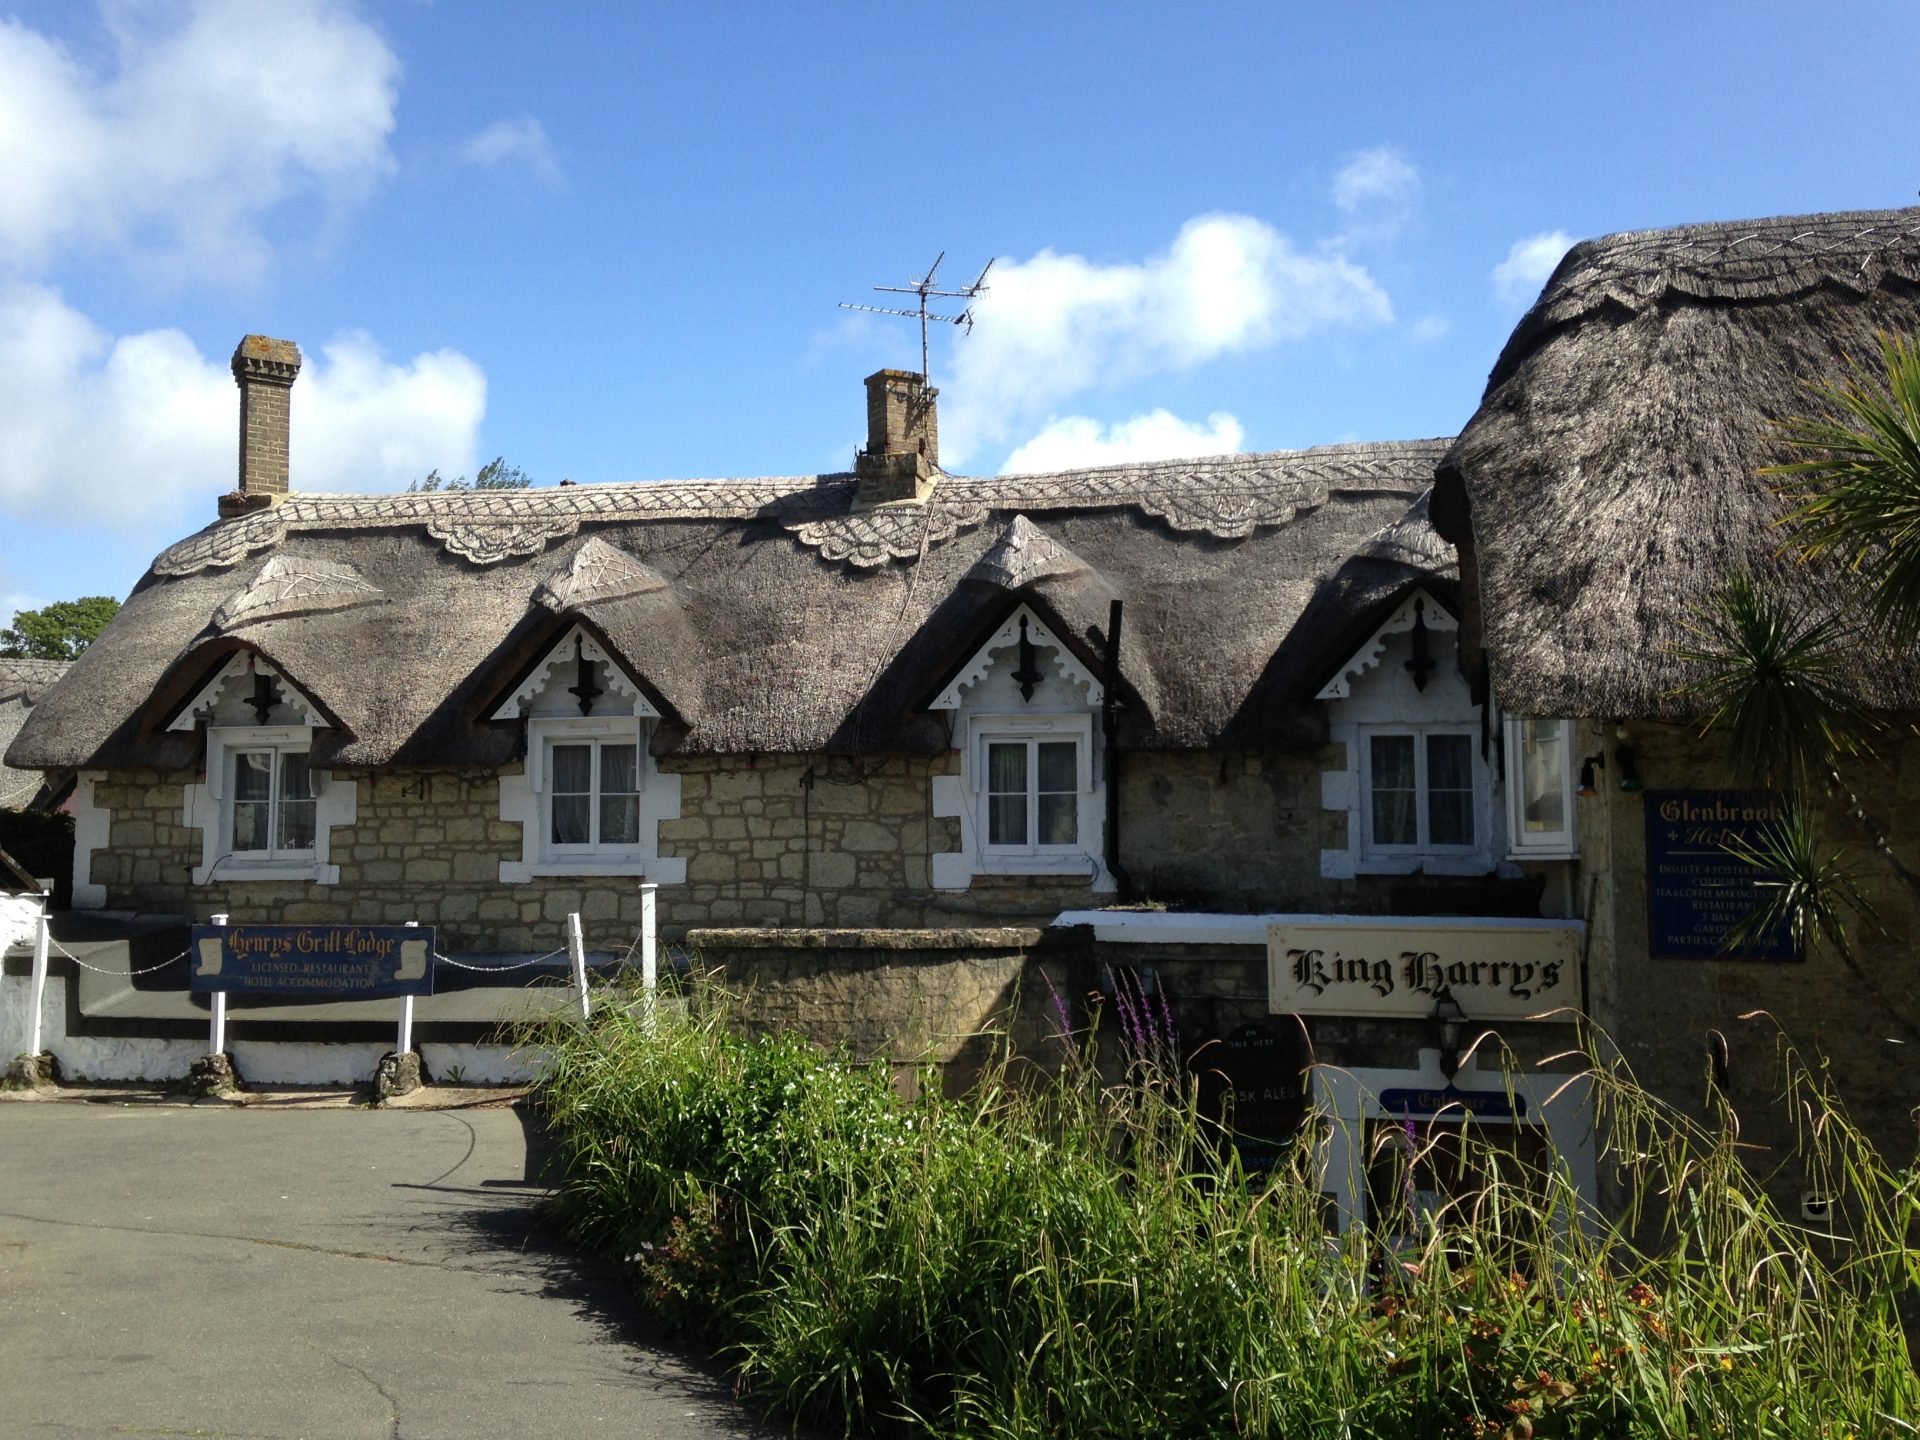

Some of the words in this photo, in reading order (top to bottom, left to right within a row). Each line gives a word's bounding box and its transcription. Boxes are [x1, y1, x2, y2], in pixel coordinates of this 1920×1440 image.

[1684, 826, 1746, 846] Hotel
[1659, 864, 1700, 875] ENSUITE
[1703, 865, 1710, 875] 4
[228, 927, 292, 960] Henrys
[296, 929, 341, 953] Grill
[344, 928, 396, 961] Lodge
[252, 962, 297, 974] LICENSED
[303, 962, 369, 975] RESTAURANT
[1286, 948, 1395, 998] King
[1400, 951, 1564, 1001] Harry's
[244, 976, 272, 988] HOTEL
[276, 977, 376, 990] ACCOMMODATION
[1263, 1085, 1297, 1101] ALES
